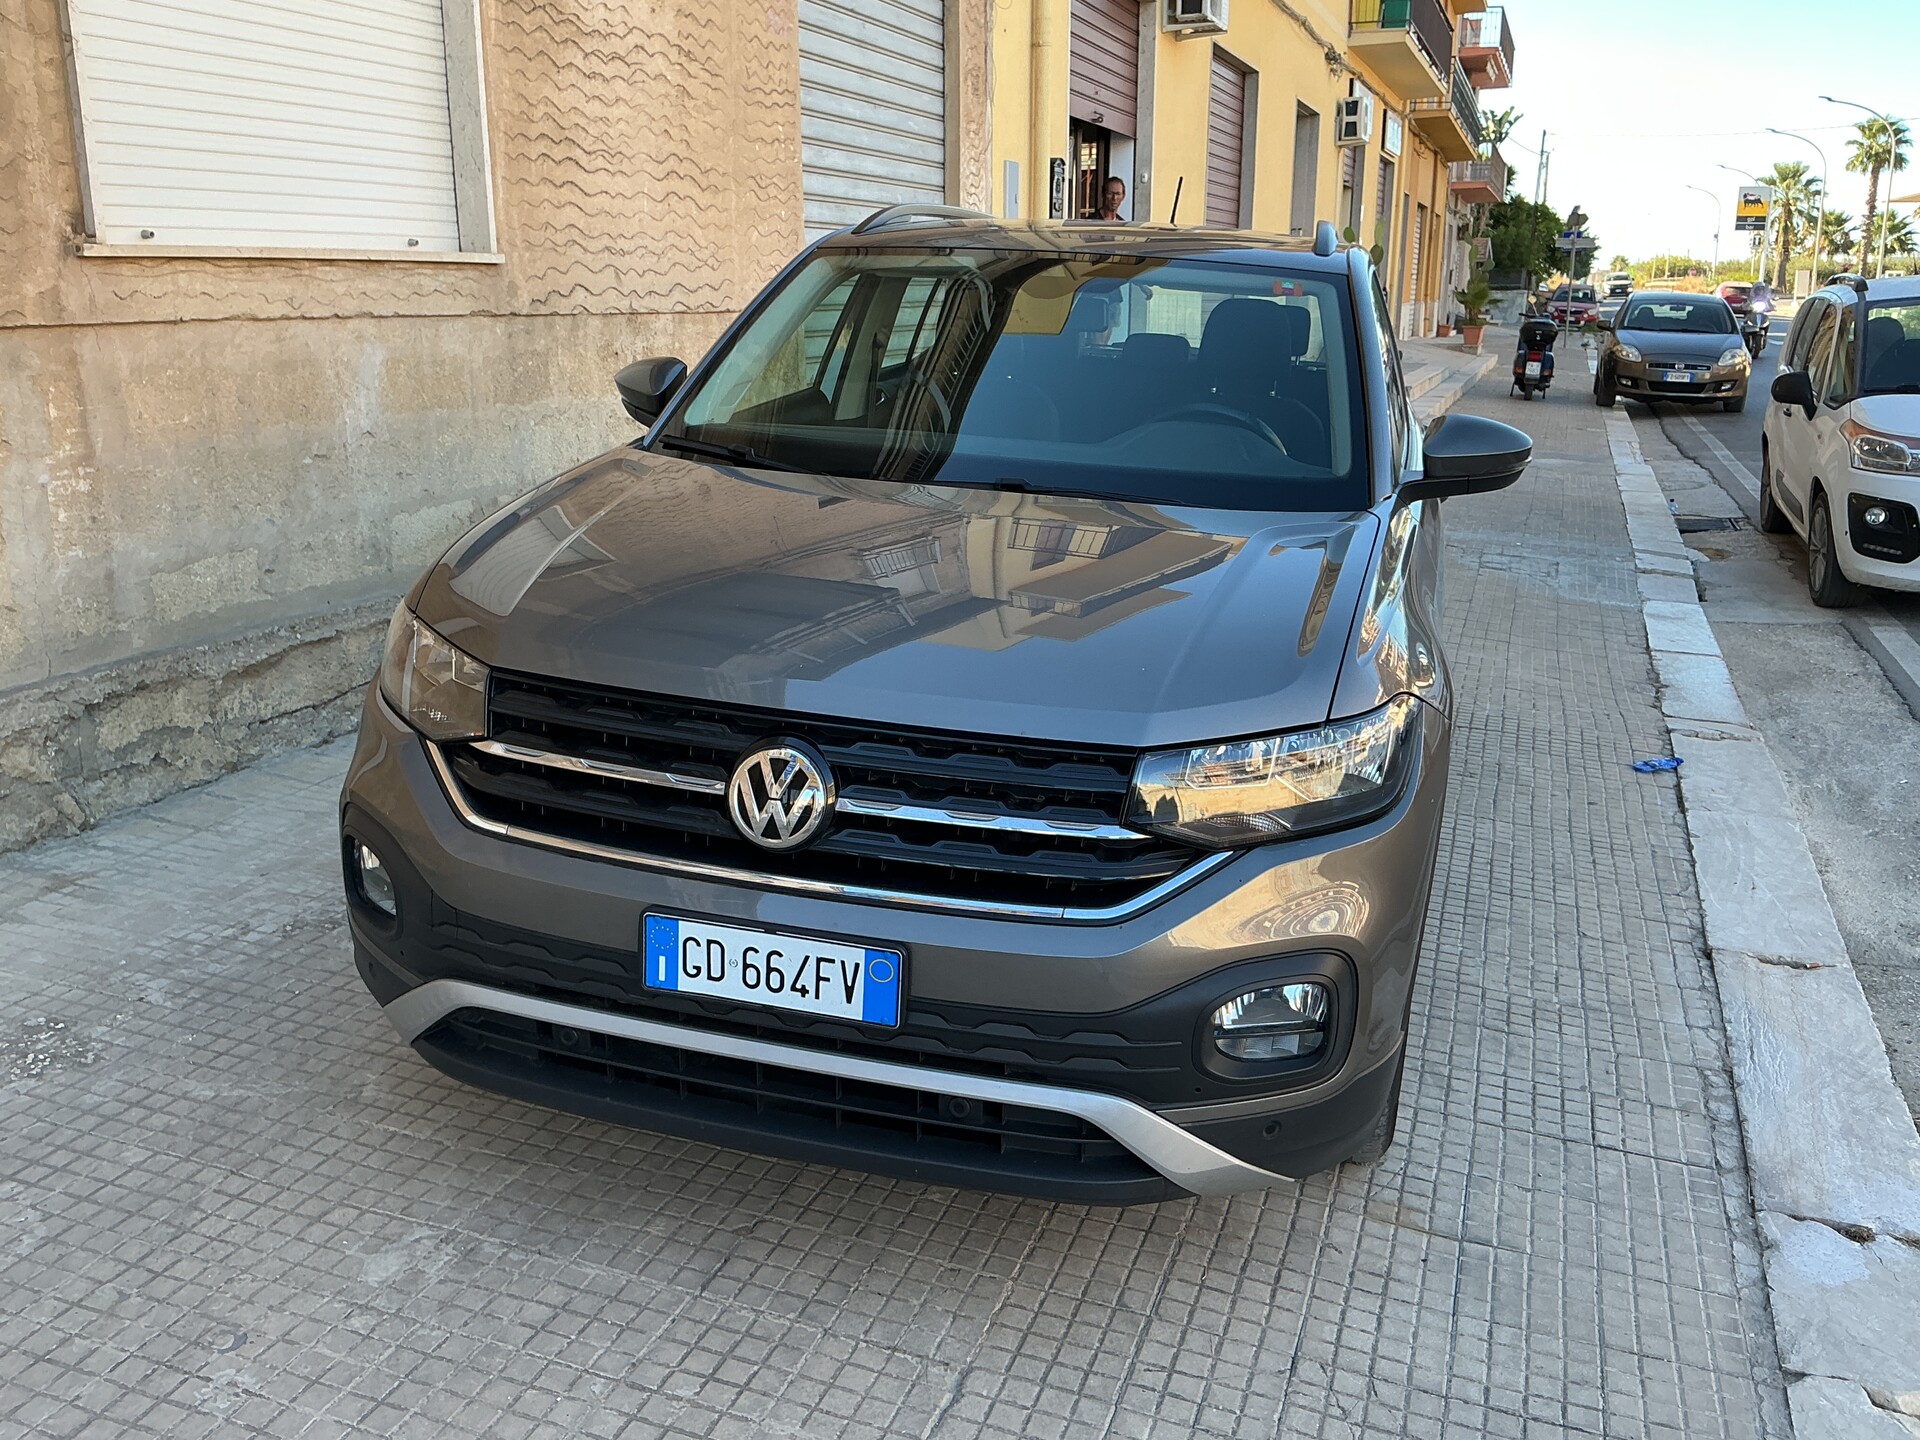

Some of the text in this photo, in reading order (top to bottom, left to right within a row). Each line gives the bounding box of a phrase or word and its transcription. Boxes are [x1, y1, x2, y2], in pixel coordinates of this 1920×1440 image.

[731, 750, 822, 845] VW
[682, 936, 861, 1004] GD 664FV
